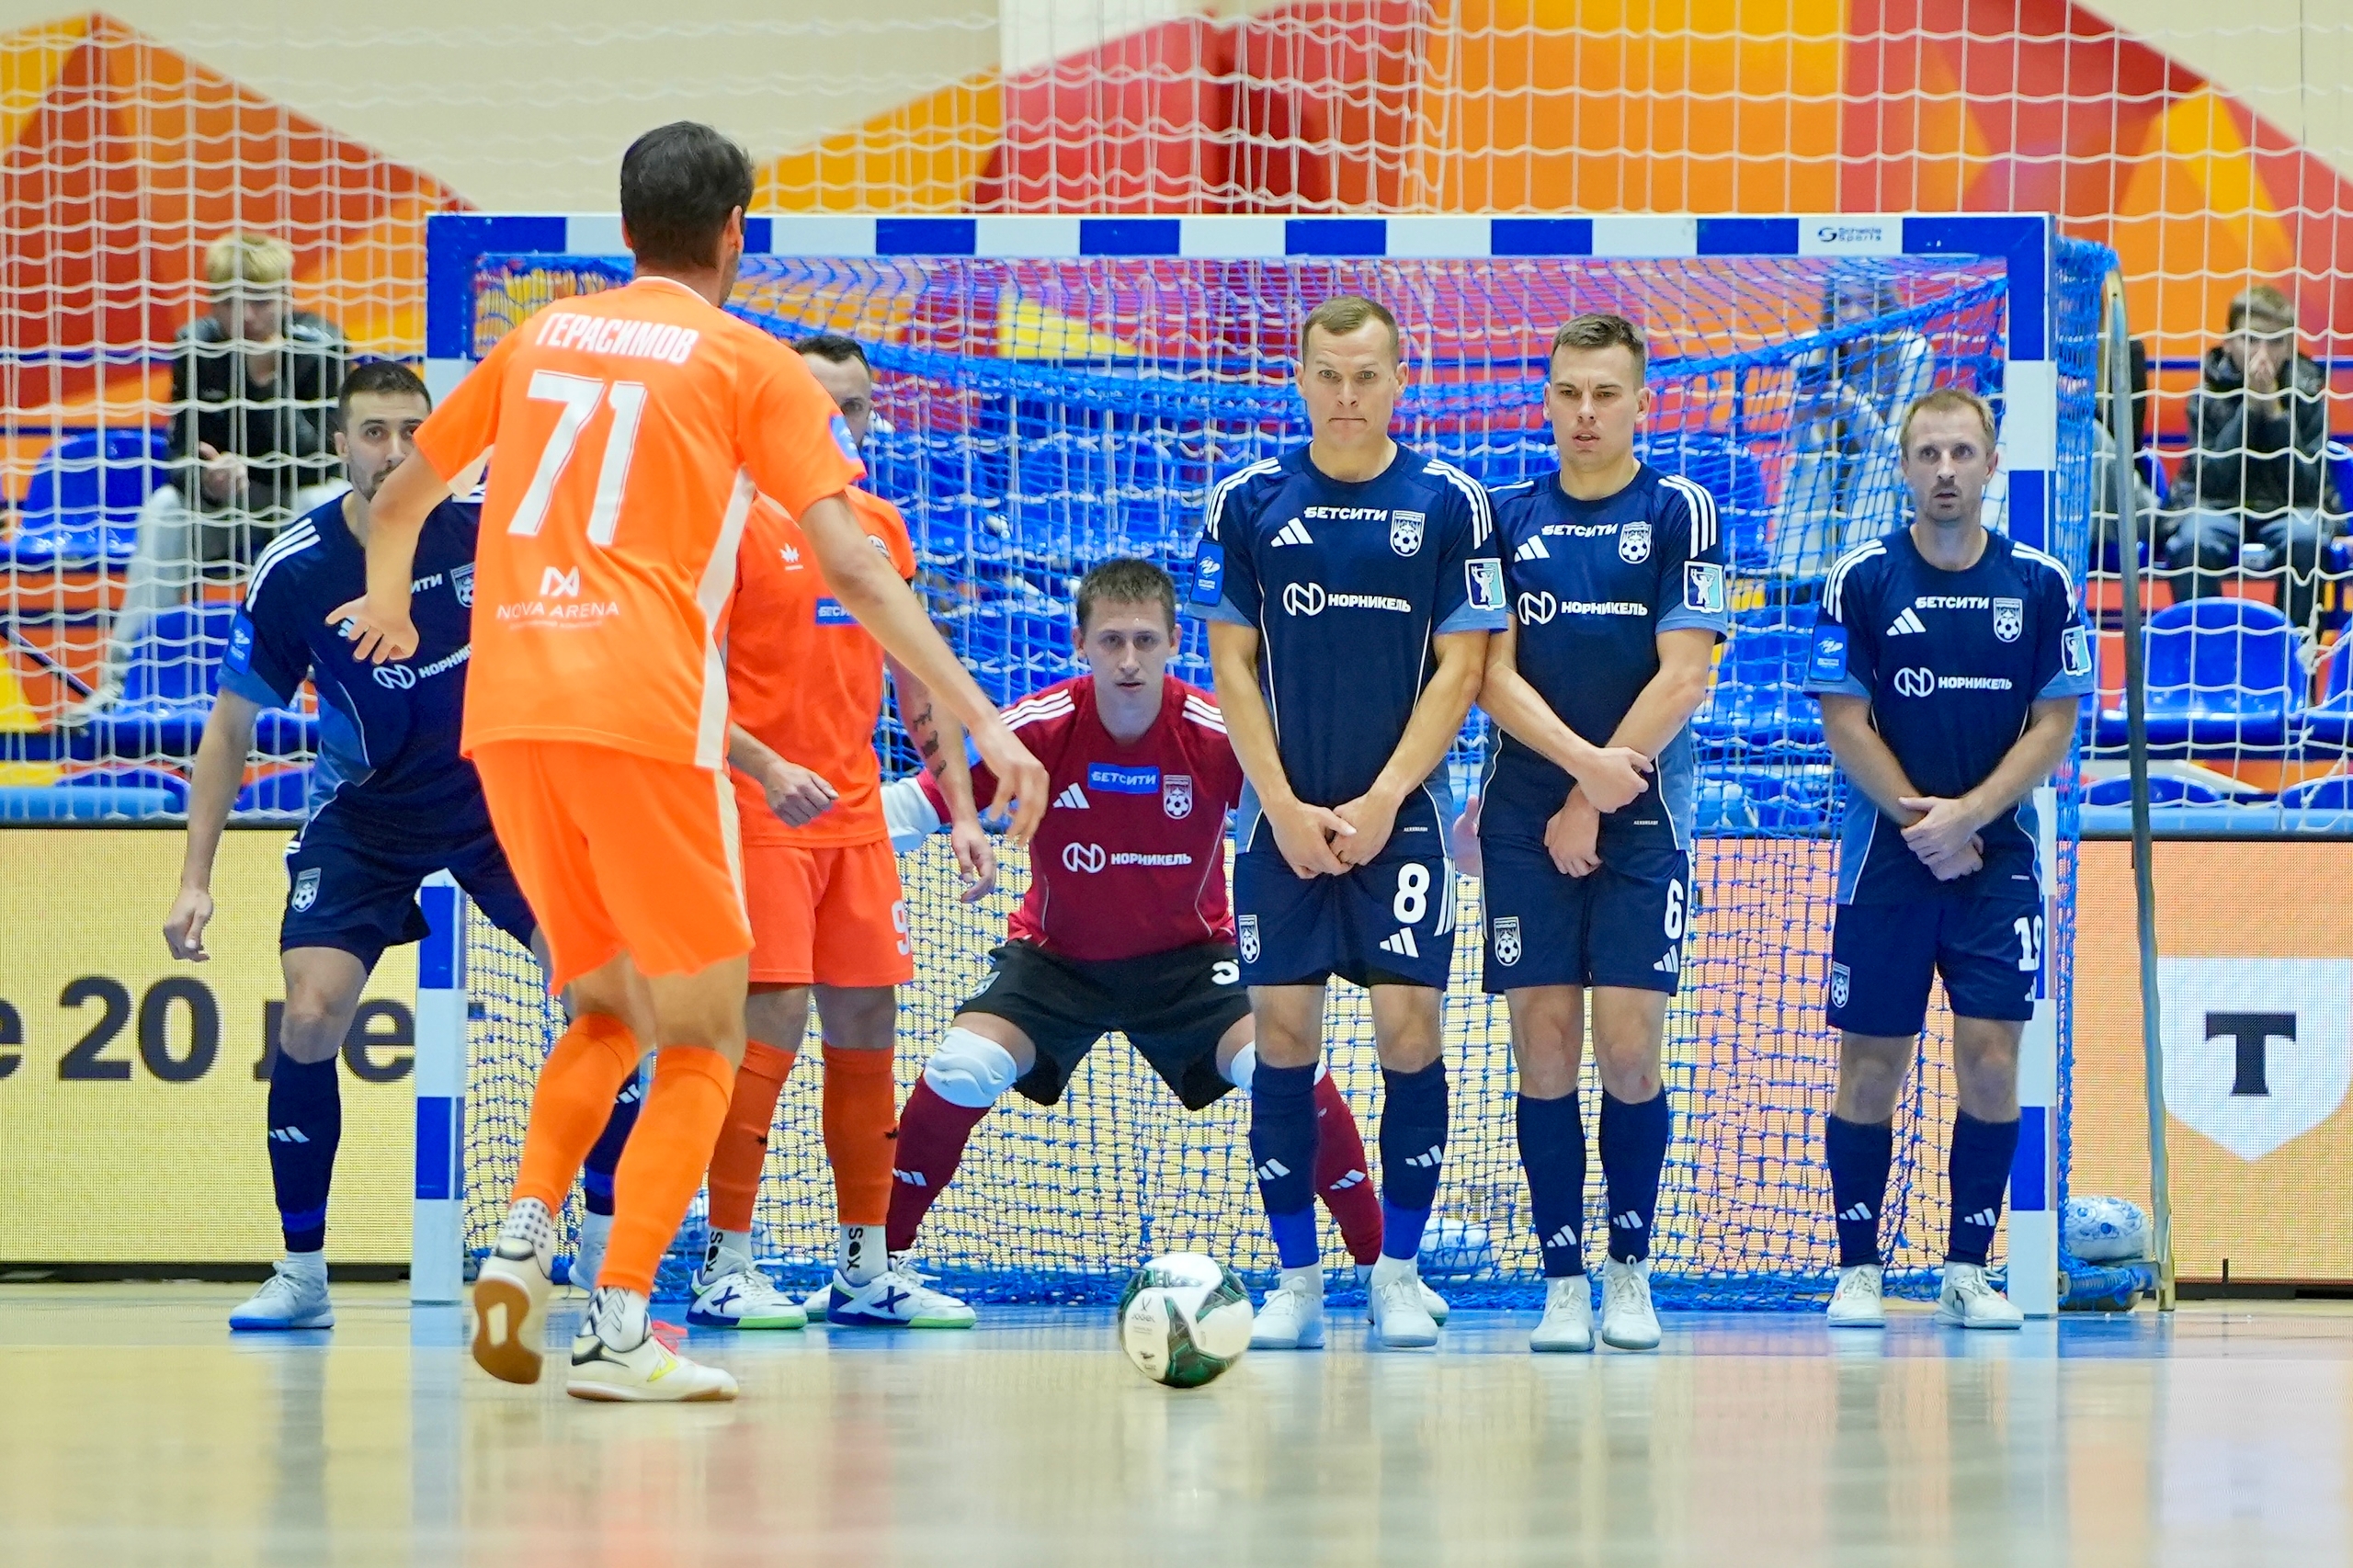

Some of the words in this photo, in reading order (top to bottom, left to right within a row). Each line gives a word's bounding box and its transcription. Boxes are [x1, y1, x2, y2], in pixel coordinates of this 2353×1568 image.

[536, 312, 699, 365] ГЕРАСИМОВ
[507, 369, 648, 546] 71
[1303, 506, 1388, 522] БЕТСИТИ
[1540, 523, 1619, 538] БЕТСИТИ
[411, 573, 443, 594] ИТИ
[496, 601, 545, 619] NOVA
[549, 601, 620, 619] ARENA
[1327, 594, 1412, 613] НОРНИКЕЛЬ
[1561, 601, 1649, 616] НОРНИКЕЛЬ
[1915, 596, 1990, 609] БЕТСИТИ
[1938, 676, 2013, 690] НОРНИКЕЛЬ
[1091, 770, 1157, 786] БЕТСИТИ
[1110, 852, 1193, 866] НОРНИКЕЛЬ
[1393, 862, 1430, 924] 8
[1664, 878, 1685, 939] 6
[60, 976, 221, 1083] 20
